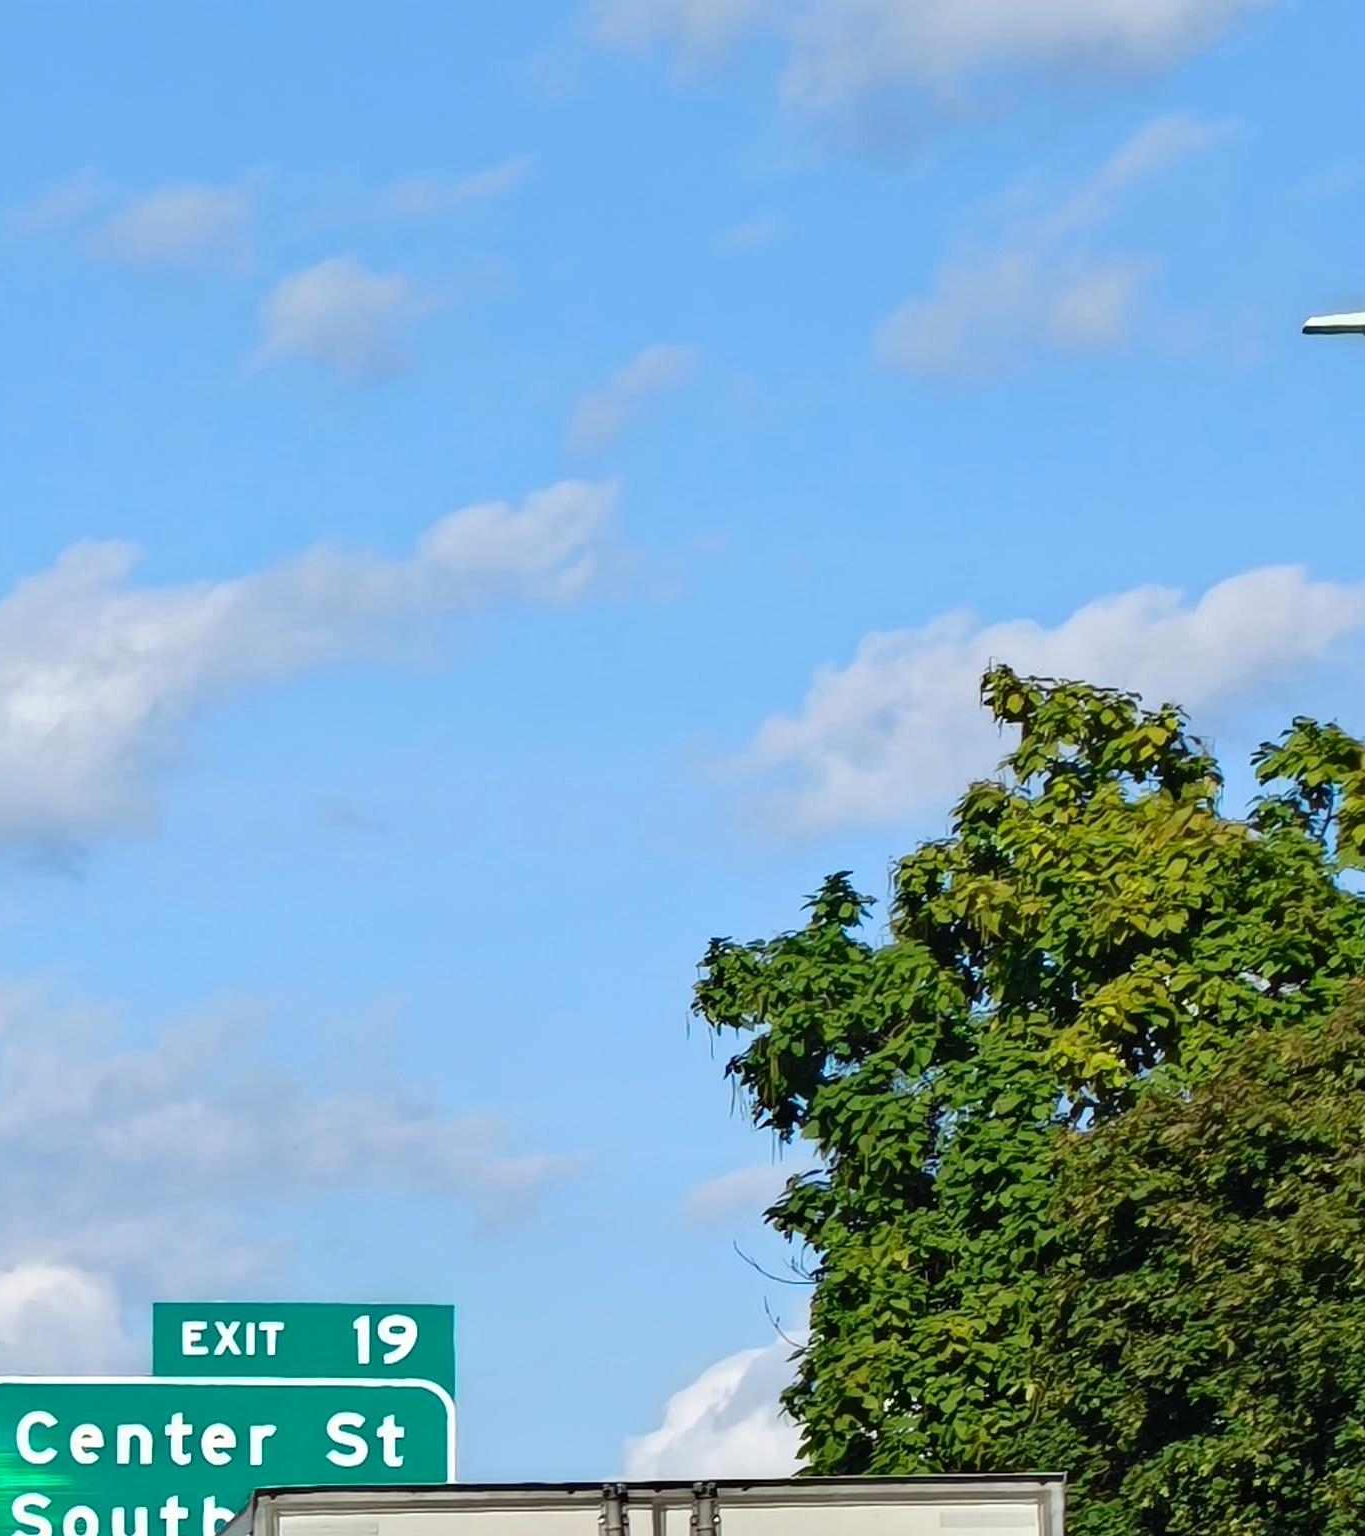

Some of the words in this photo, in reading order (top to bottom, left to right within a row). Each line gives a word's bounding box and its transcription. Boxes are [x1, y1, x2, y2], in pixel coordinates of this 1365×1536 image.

[181, 1320, 285, 1356] EXIT
[352, 1314, 418, 1365] 19
[16, 1410, 277, 1466] Center
[326, 1411, 405, 1468] St
